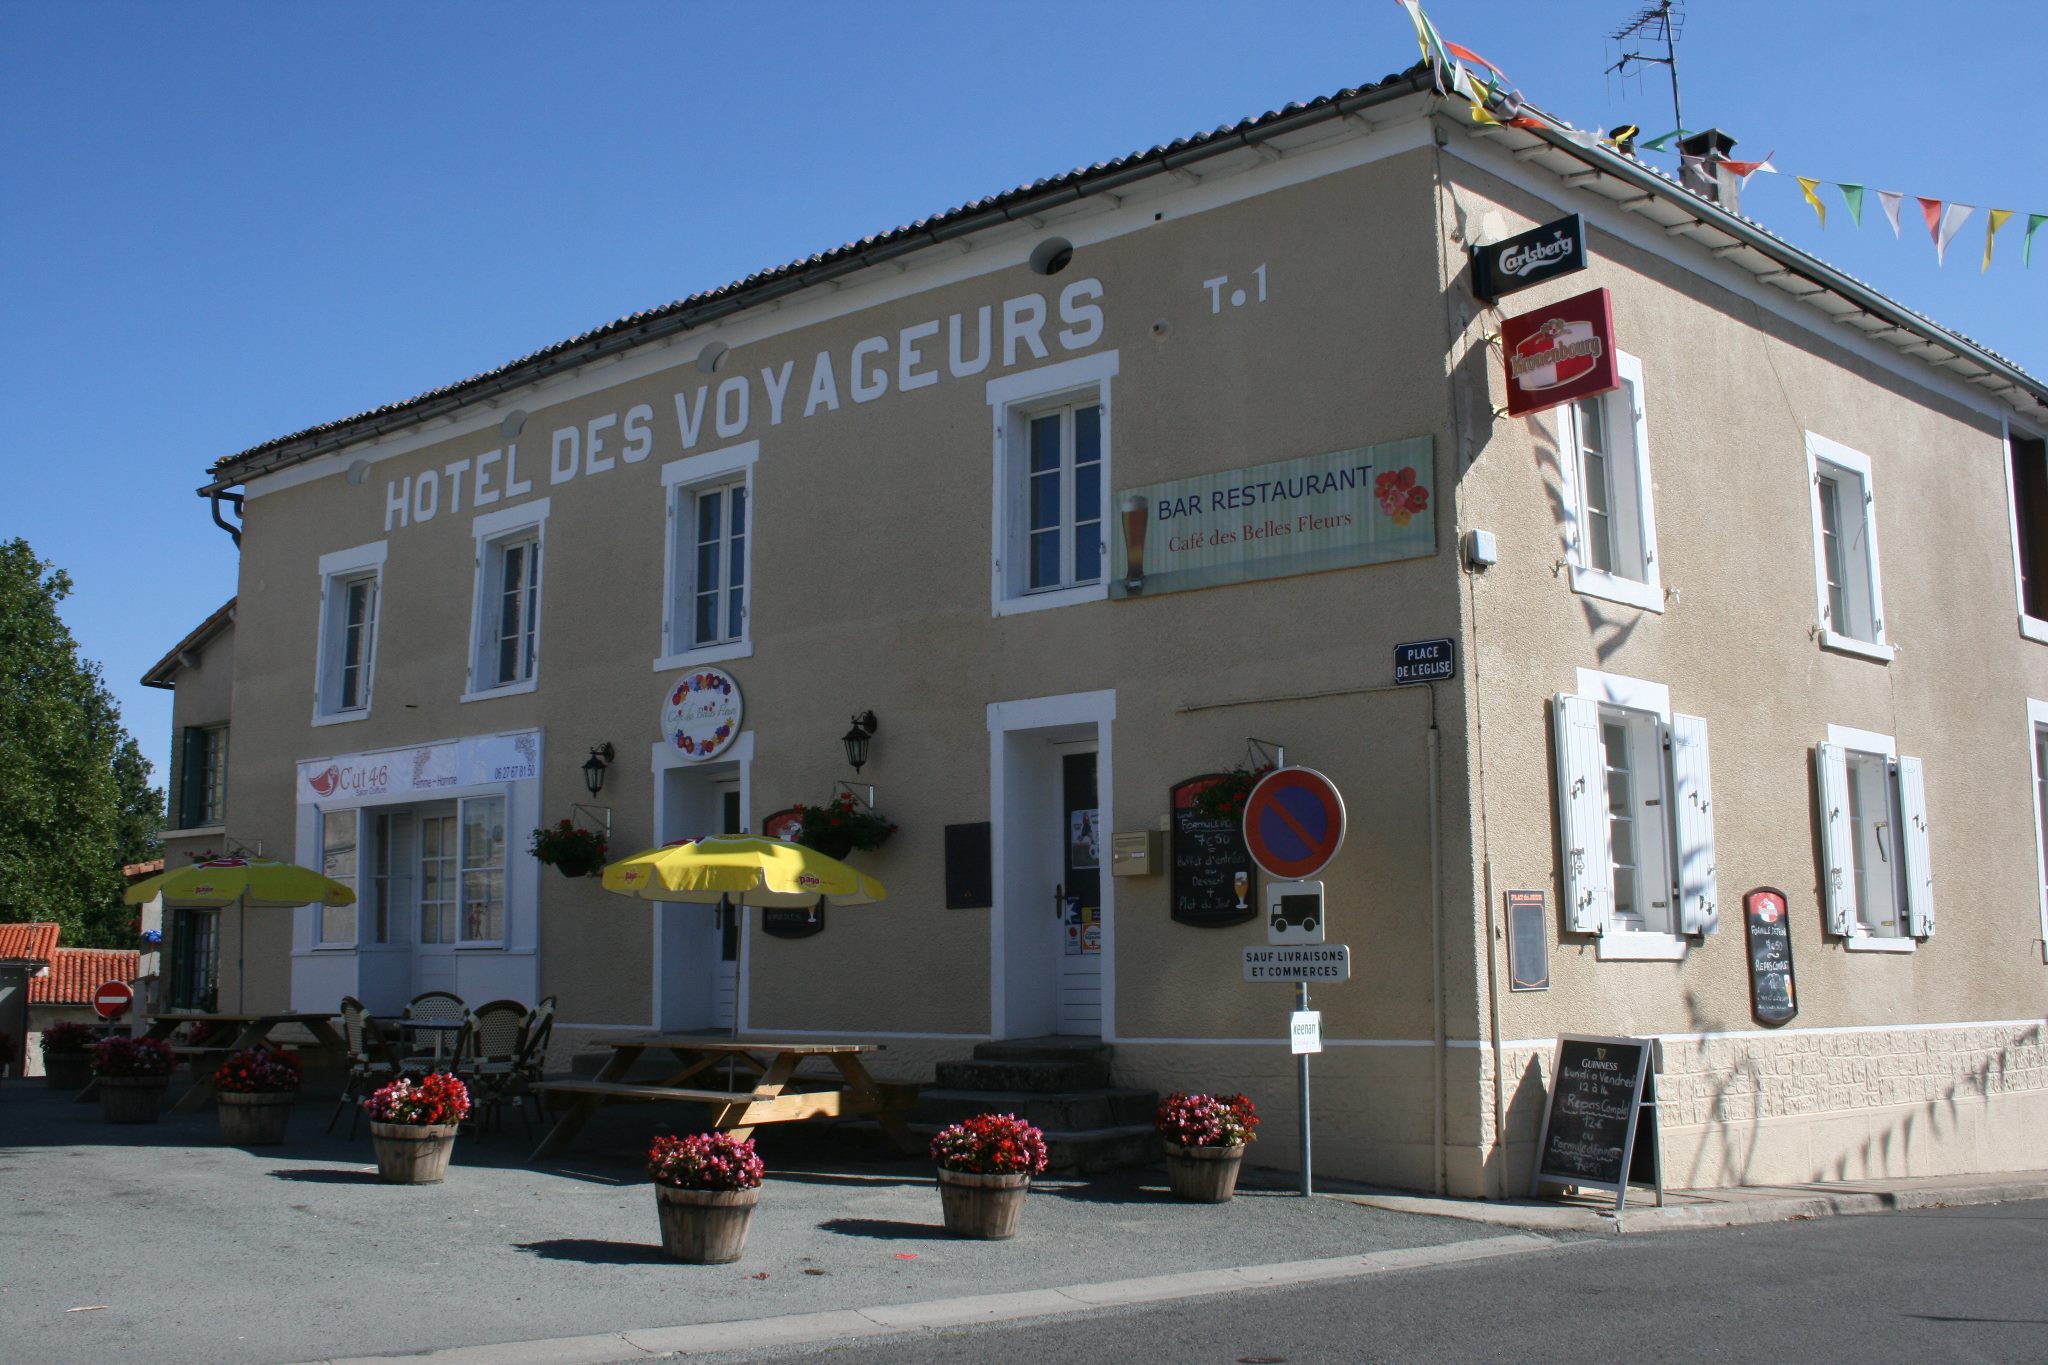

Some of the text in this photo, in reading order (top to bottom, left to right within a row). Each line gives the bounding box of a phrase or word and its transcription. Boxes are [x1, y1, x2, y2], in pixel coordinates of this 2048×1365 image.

[1499, 232, 1573, 275] Carlsberg
[1511, 335, 1602, 379] Kronenbourg
[384, 277, 1105, 531] HOTEL DES VOYAGEURS
[1158, 465, 1372, 521] BAR RESTAURANT
[1168, 511, 1352, 553] Café des Belles Fleurs
[1407, 646, 1439, 661] PLACE
[1397, 665, 1409, 678] DE
[800, 876, 820, 886] pago
[1246, 951, 1344, 962] SAUF LIVRAISONS
[1252, 966, 1338, 977] ET COMMERCES
[1581, 1058, 1618, 1071] GUINNESS
[1564, 1067, 1589, 1080] Lundi
[1579, 1082, 1589, 1092] 12
